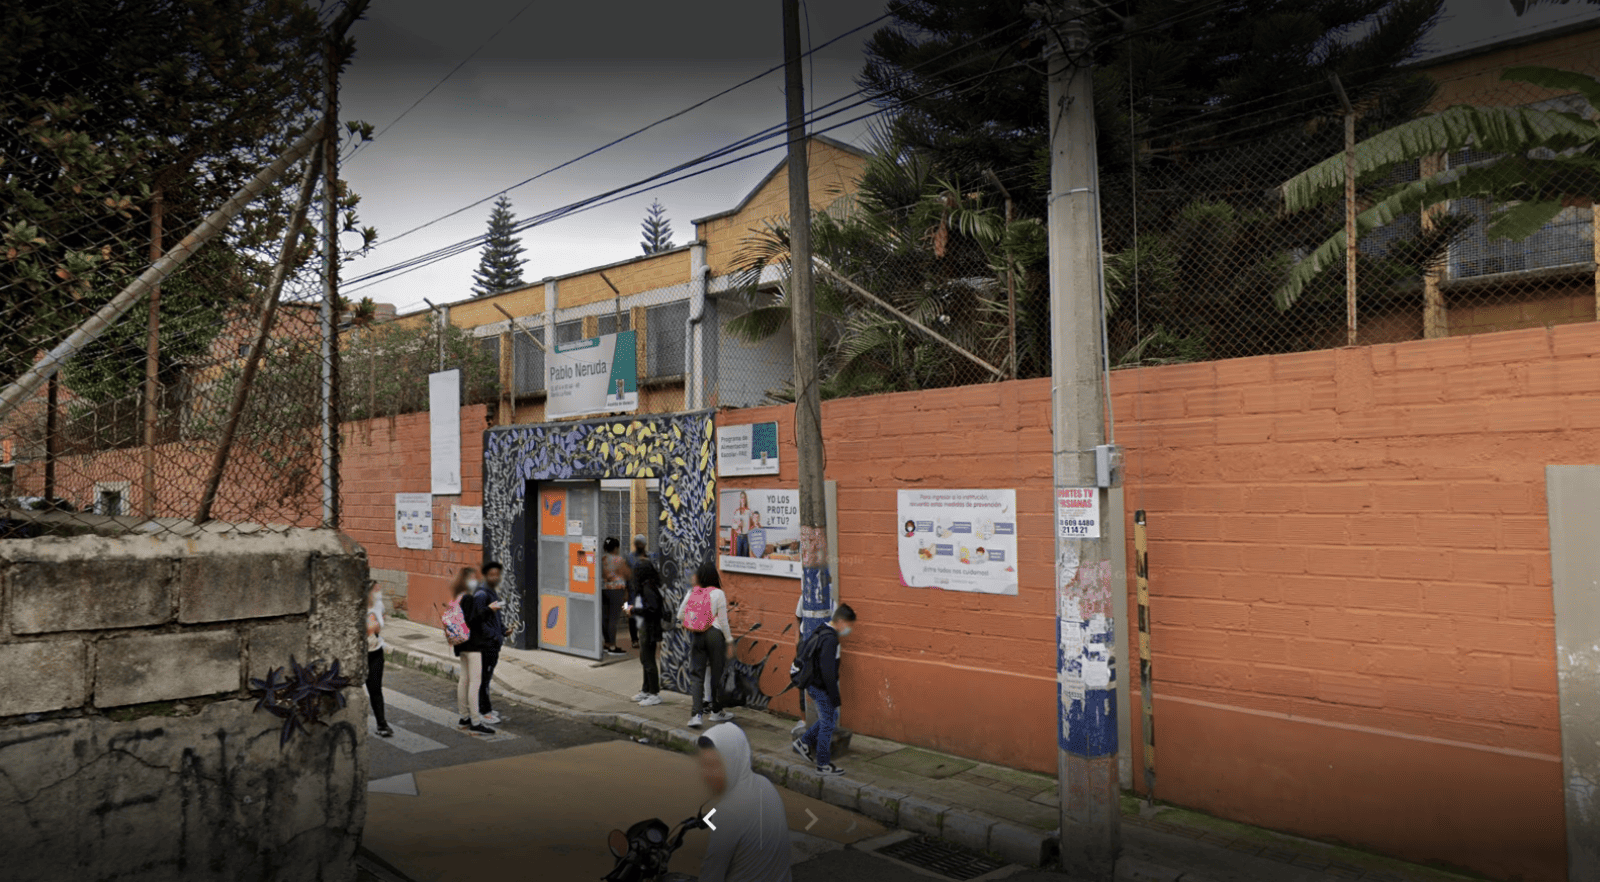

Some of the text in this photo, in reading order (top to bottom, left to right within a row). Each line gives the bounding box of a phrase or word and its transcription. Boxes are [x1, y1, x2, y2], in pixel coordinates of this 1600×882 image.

[550, 360, 607, 380] Pablo Neruda
[1083, 489, 1093, 498] TV
[767, 495, 790, 504] YO LOS
[767, 505, 797, 515] PROTEJO
[767, 514, 790, 526] ¿Y TÚ?
